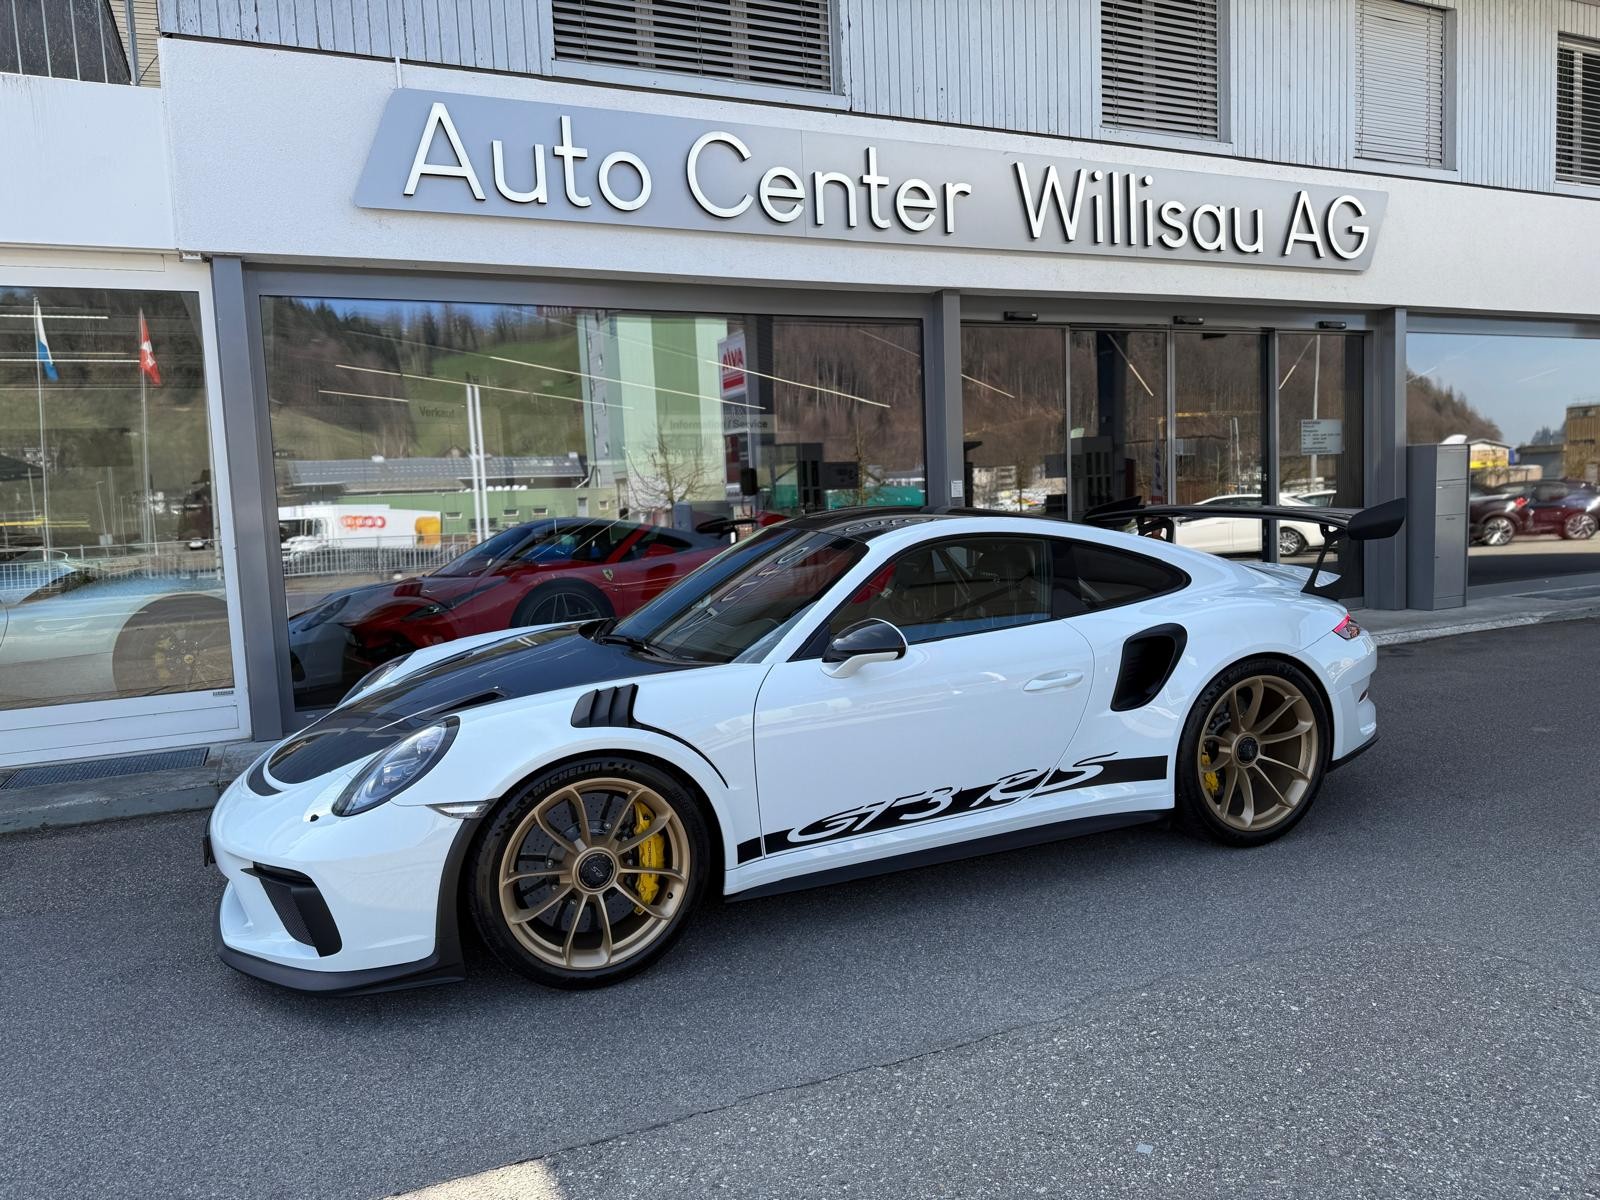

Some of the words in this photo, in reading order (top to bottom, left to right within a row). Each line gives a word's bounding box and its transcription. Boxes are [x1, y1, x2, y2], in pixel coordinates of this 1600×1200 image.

[403, 102, 652, 212] Auto
[686, 131, 972, 234] Center
[1012, 161, 1264, 254] Willisau
[1283, 189, 1371, 260] AG
[532, 762, 602, 797] MICHELIN
[787, 786, 956, 844] GT3
[969, 751, 1118, 807] RS
